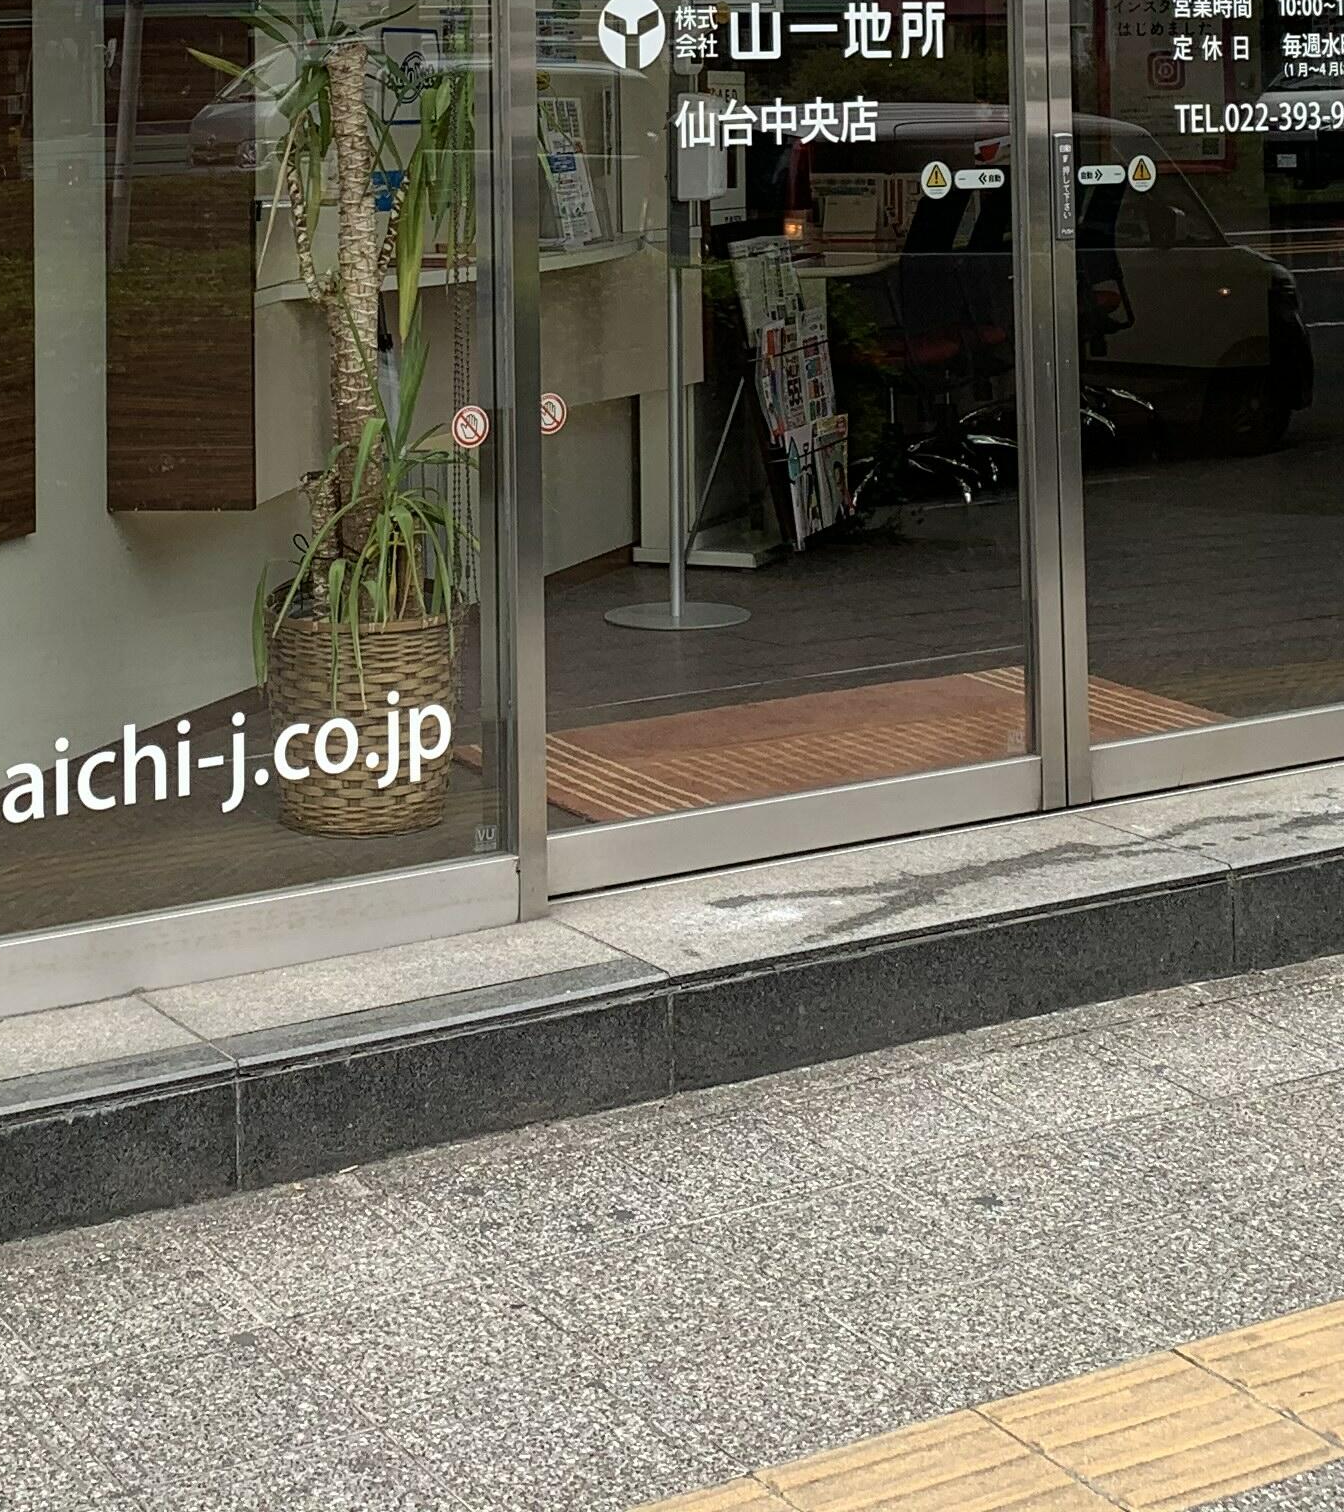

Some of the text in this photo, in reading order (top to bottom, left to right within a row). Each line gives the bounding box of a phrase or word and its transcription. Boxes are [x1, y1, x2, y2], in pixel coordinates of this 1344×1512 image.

[674, 5, 718, 31] 株式
[730, 1, 946, 60] 山一地所
[675, 33, 719, 59] 会社
[674, 95, 879, 149] 仙台中央店
